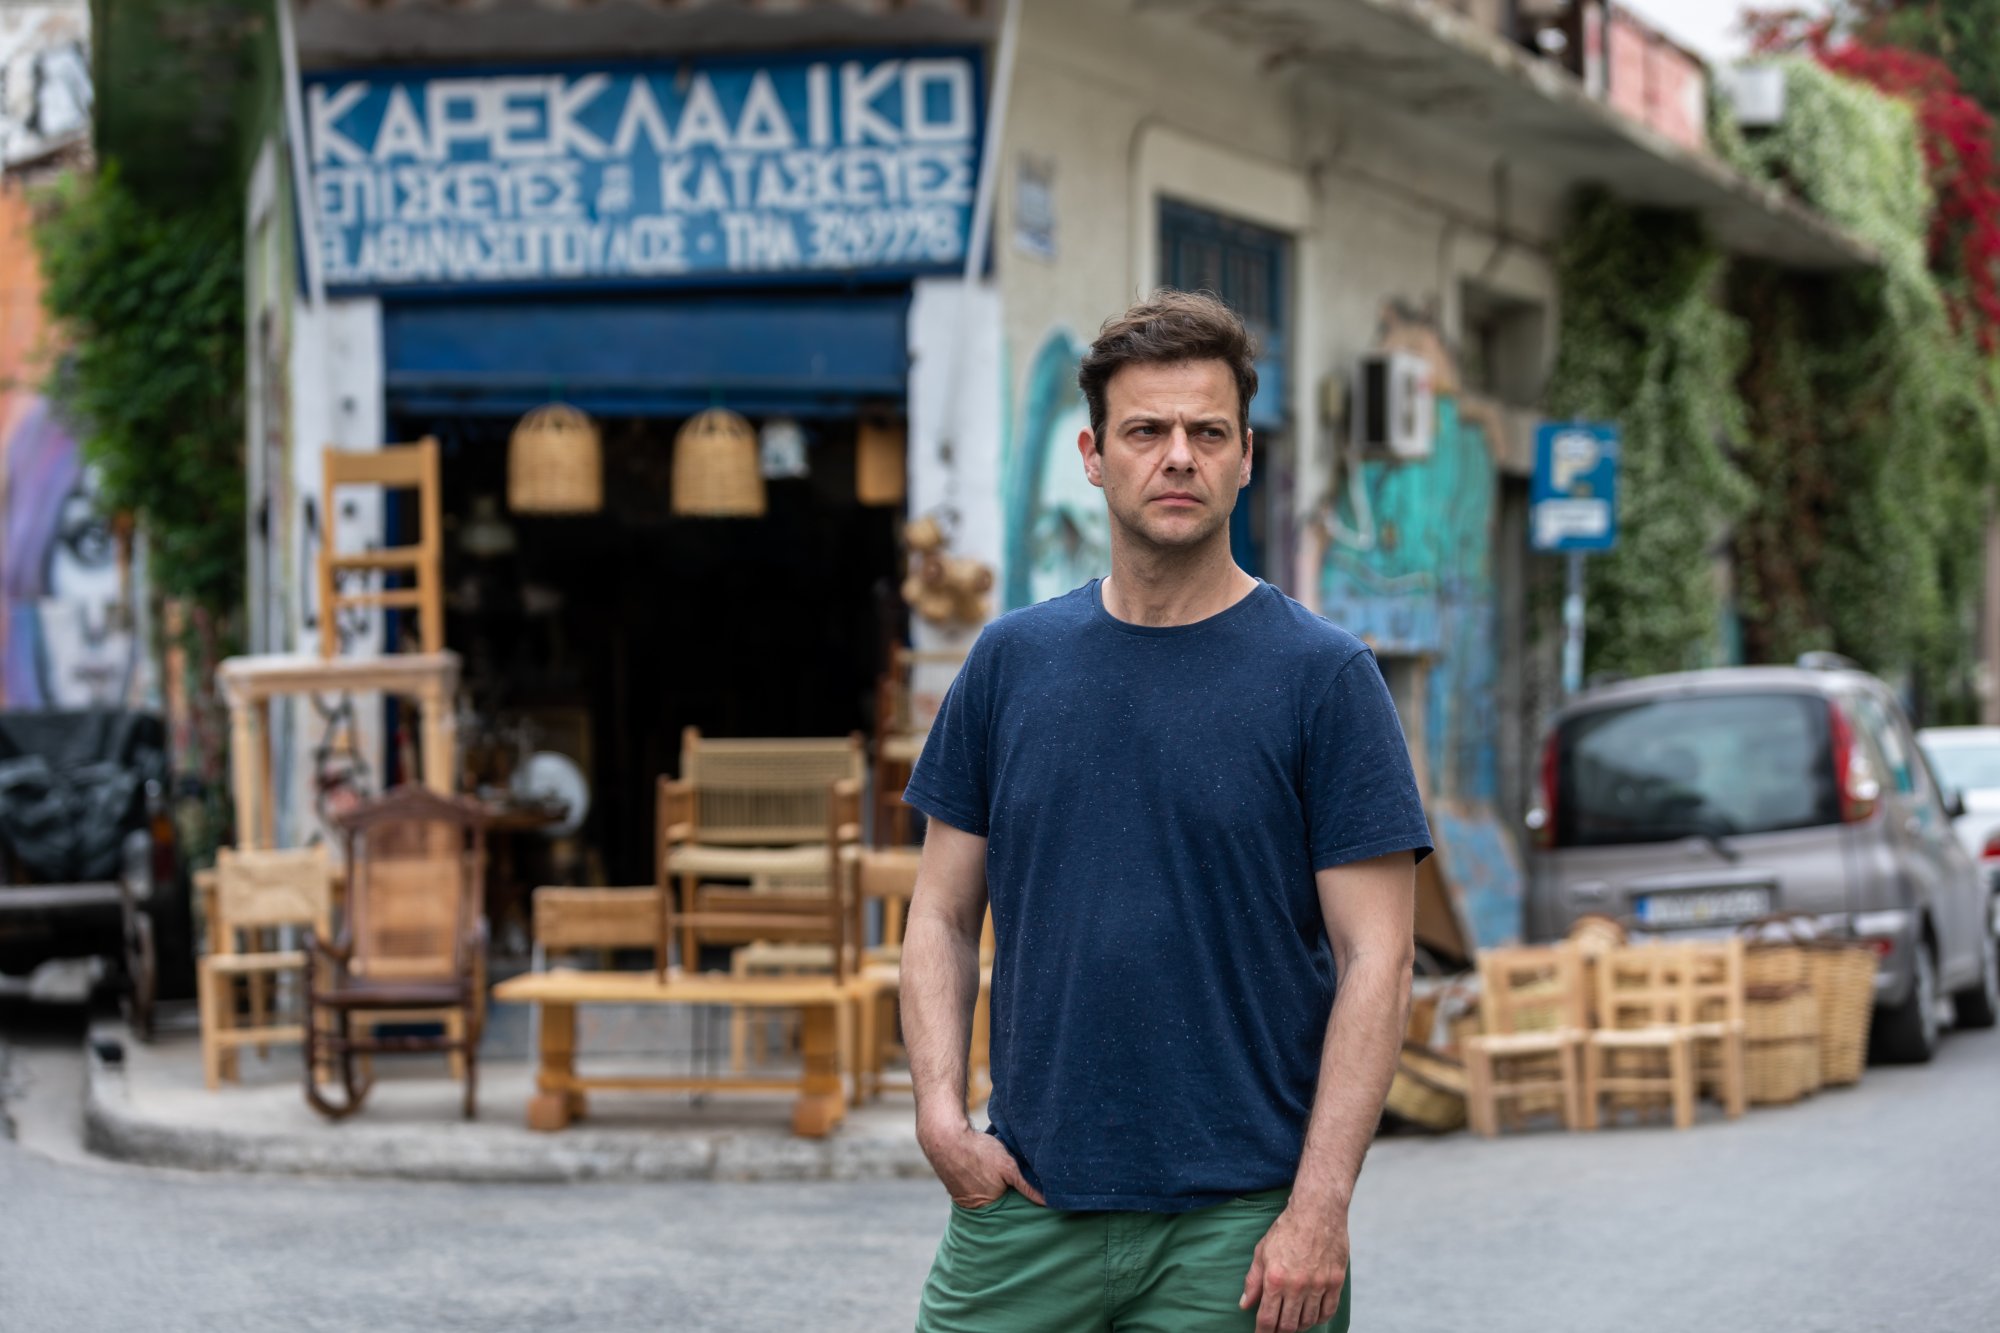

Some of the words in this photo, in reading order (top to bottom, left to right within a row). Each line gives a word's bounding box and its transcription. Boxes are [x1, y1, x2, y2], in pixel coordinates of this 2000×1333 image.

[307, 59, 975, 163] ΚΑΡΕΚΛΑΔΙΚΟ
[313, 160, 584, 223] ΕΠΙΣΚΕΥΕΣ
[659, 148, 974, 211] ΚΑΤΑΣΚΕΥΕΣ
